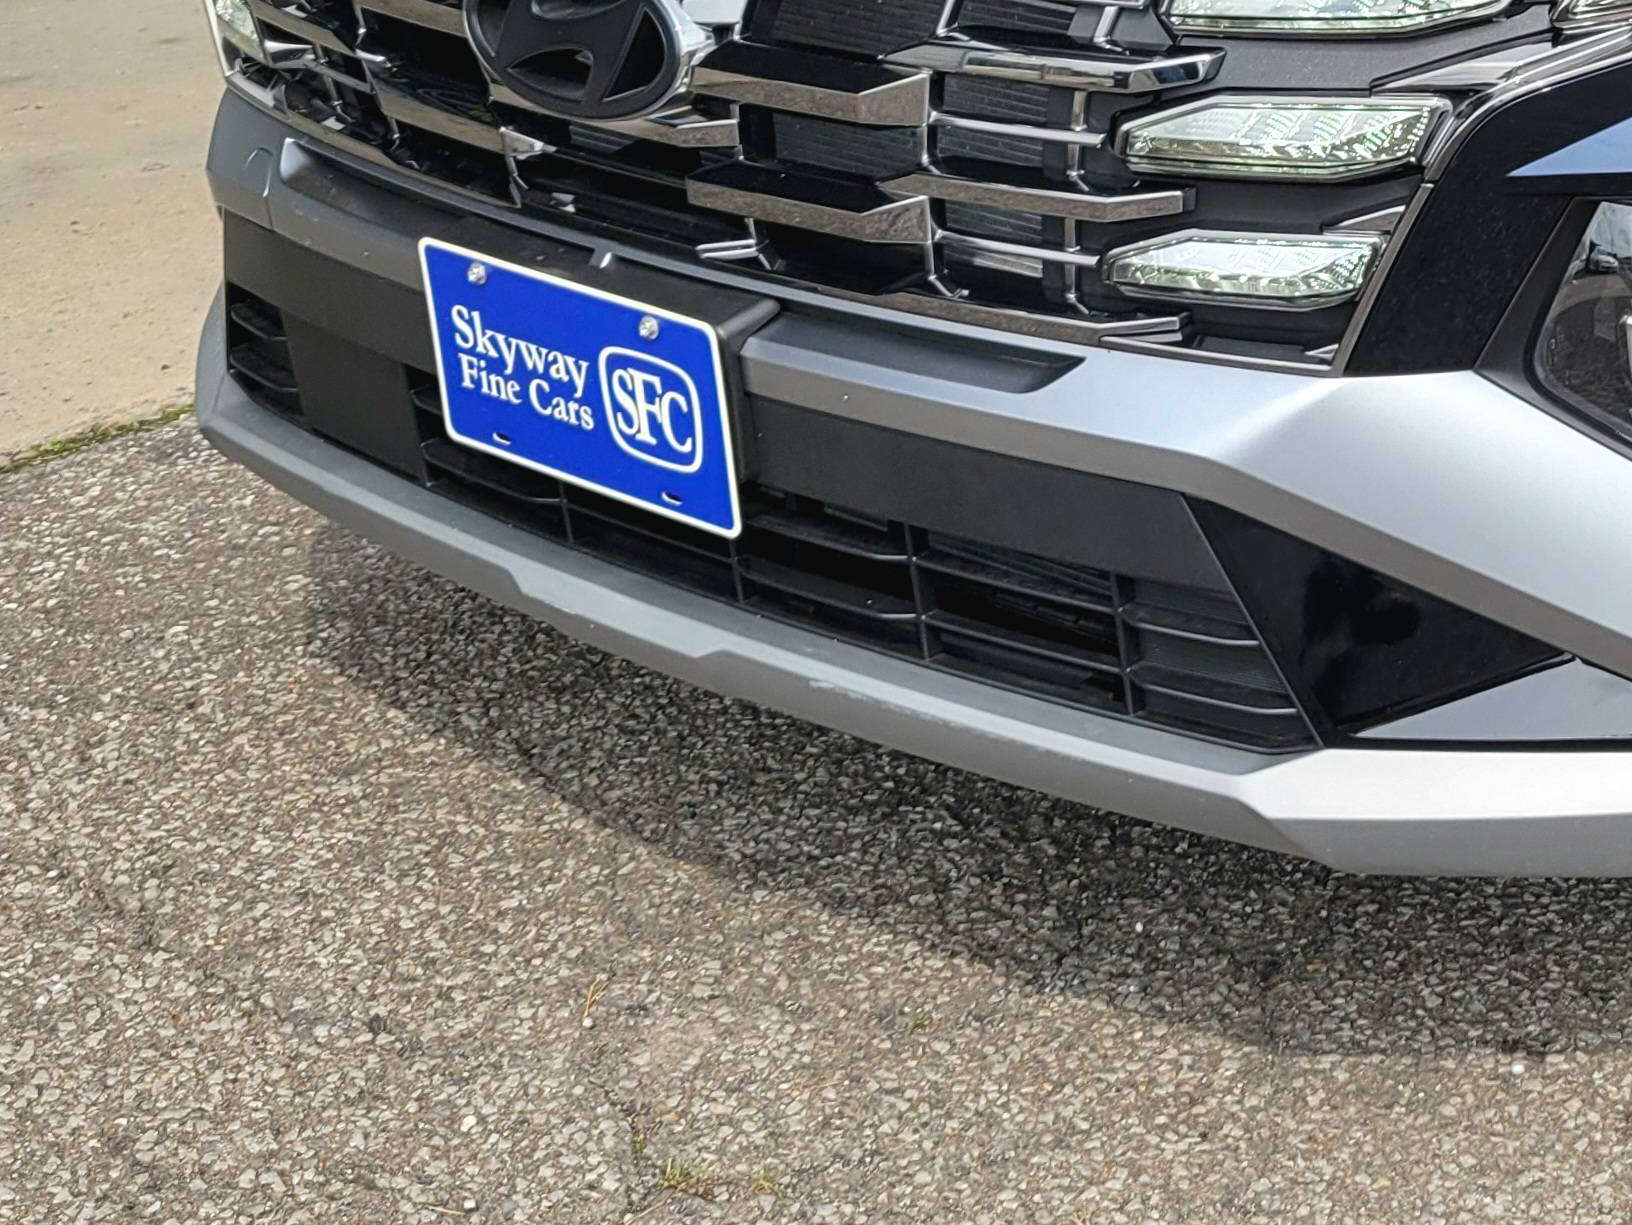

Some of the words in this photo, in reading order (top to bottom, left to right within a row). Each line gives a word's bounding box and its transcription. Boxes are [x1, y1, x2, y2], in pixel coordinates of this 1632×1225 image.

[451, 304, 589, 398] Skyway
[456, 353, 522, 405] Fine
[529, 379, 595, 431] Cars
[612, 368, 693, 453] SFC
